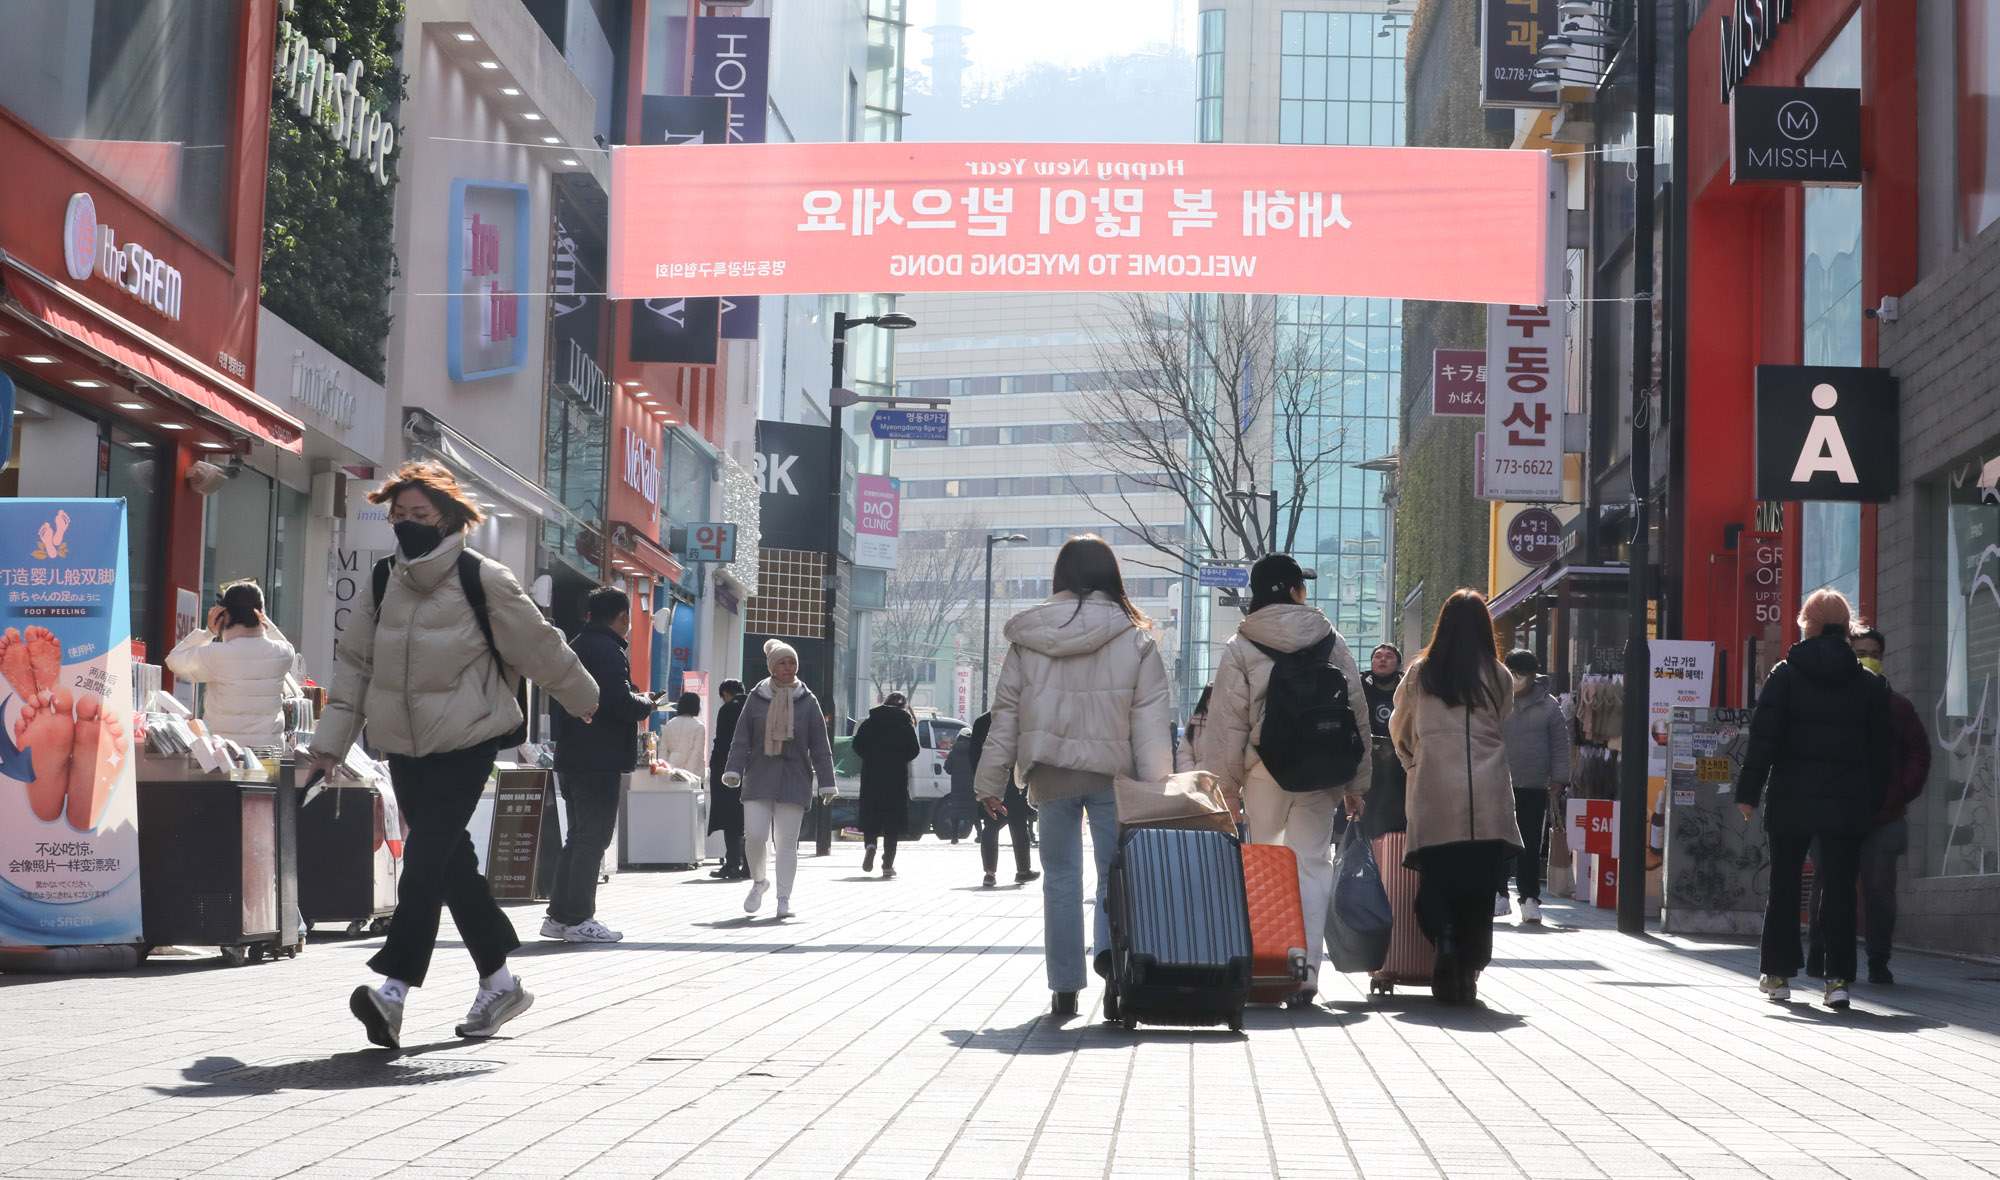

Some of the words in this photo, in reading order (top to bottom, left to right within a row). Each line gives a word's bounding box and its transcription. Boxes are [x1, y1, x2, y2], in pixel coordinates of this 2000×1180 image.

[1720, 0, 1791, 104] MISS
[275, 0, 394, 186] innisfree
[1748, 147, 1848, 169] MISSHA
[98, 225, 128, 286] the
[126, 242, 182, 321] SAEM
[569, 337, 606, 418] LLOYD
[1501, 304, 1552, 447] 부동산
[290, 349, 357, 431] innisfree
[1448, 391, 1485, 405] かばん
[906, 412, 947, 424] 명동8가길
[880, 423, 922, 432] Myeongdong
[623, 425, 661, 524] McNally
[1495, 458, 1553, 475] 773-6622
[356, 510, 388, 522] innis
[862, 517, 893, 532] CLINIC
[695, 525, 727, 560] 약
[1511, 534, 1561, 552] 성형외과
[0, 567, 115, 586] 打造婴儿般双脚
[8, 590, 101, 603] 赤ちゃんの足のように
[1755, 592, 1770, 601] UP
[24, 608, 47, 616] FOOT
[51, 608, 87, 616] PEELING
[68, 642, 96, 659] 使用中
[673, 646, 691, 665] 약
[1663, 655, 1679, 667] 신규
[1680, 656, 1697, 668] 가입
[1654, 666, 1664, 679] 첫
[1665, 667, 1684, 680] 구매
[1685, 669, 1704, 680] 혜택!
[74, 675, 113, 699] 2週間後
[8, 857, 121, 873] 会像照片一样变漂亮!
[40, 917, 56, 928] the
[57, 915, 93, 928] SAEM
